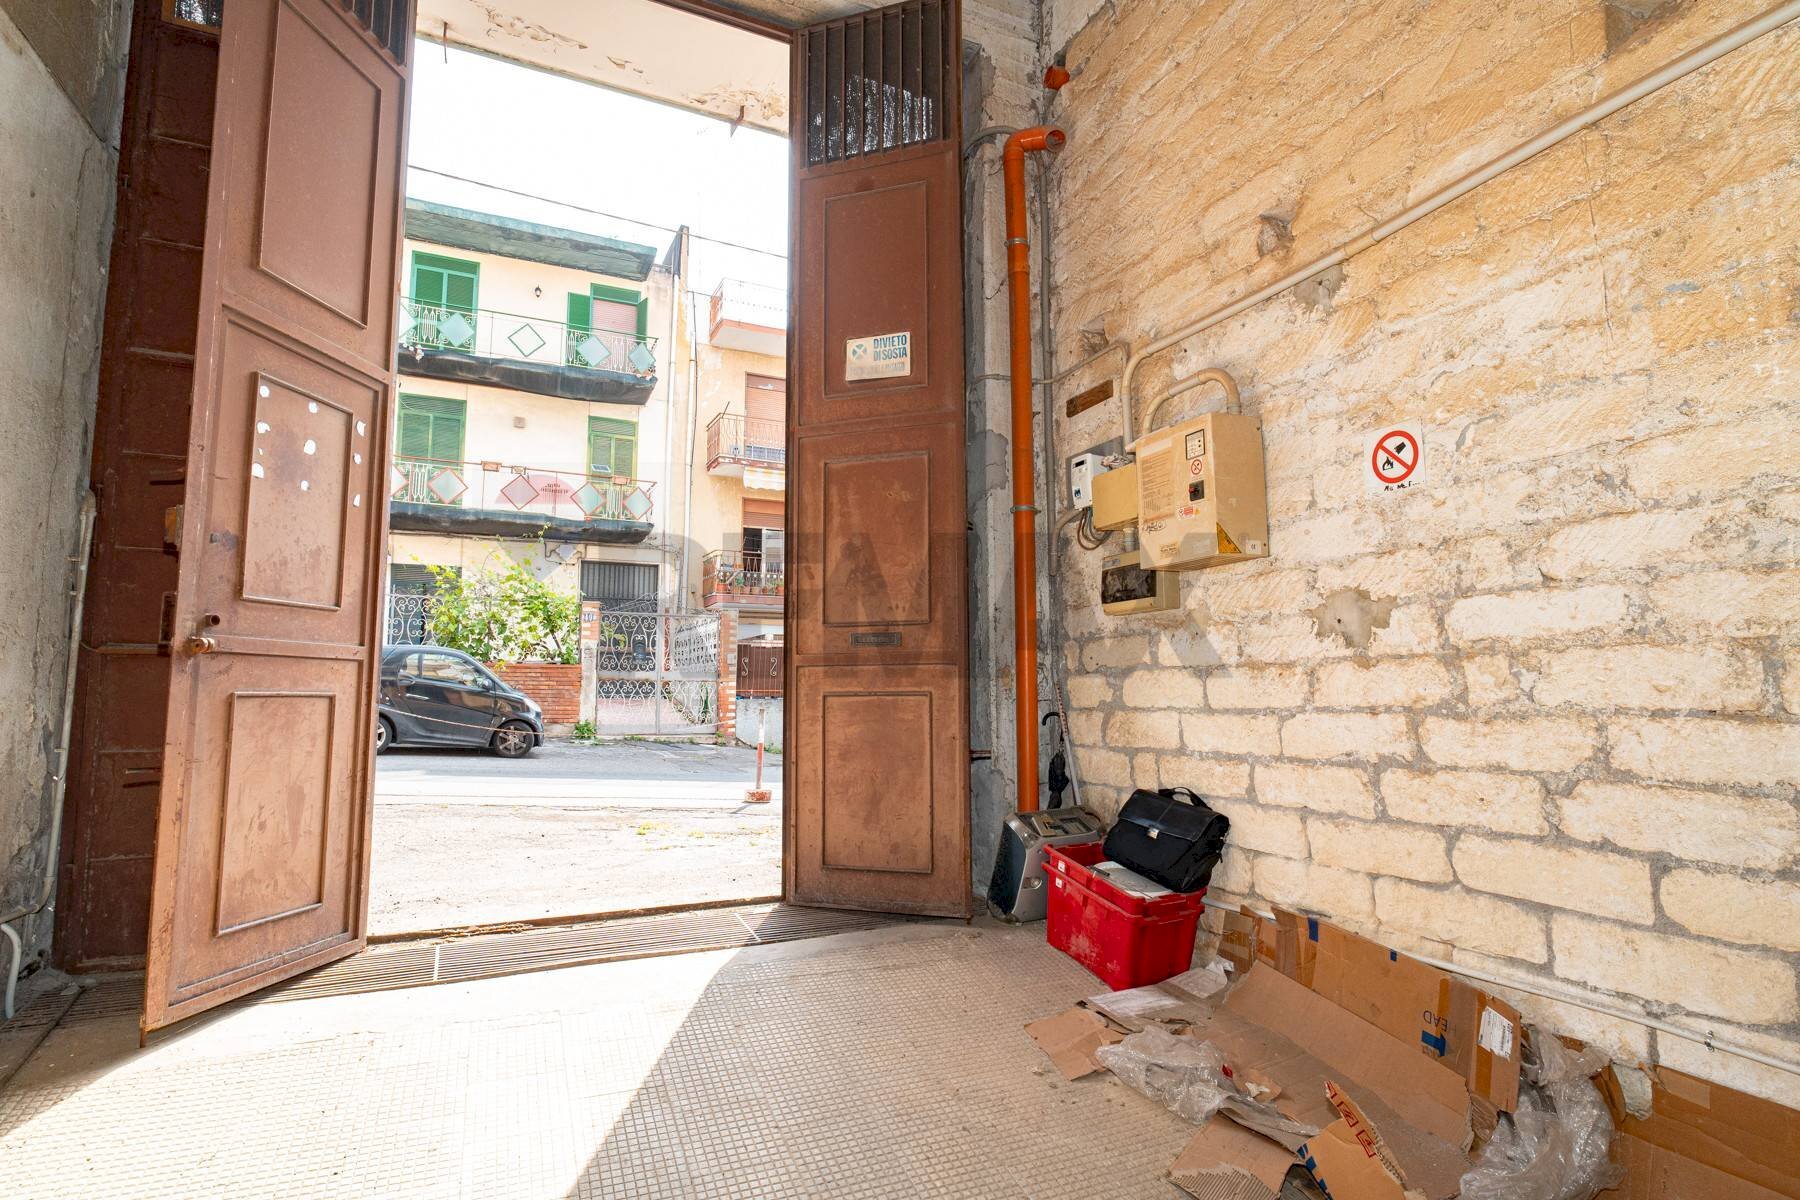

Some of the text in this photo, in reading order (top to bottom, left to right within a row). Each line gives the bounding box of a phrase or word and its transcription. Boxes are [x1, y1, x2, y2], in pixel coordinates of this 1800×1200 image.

[873, 334, 907, 350] DIVIETO
[873, 346, 908, 361] DI SOSTA
